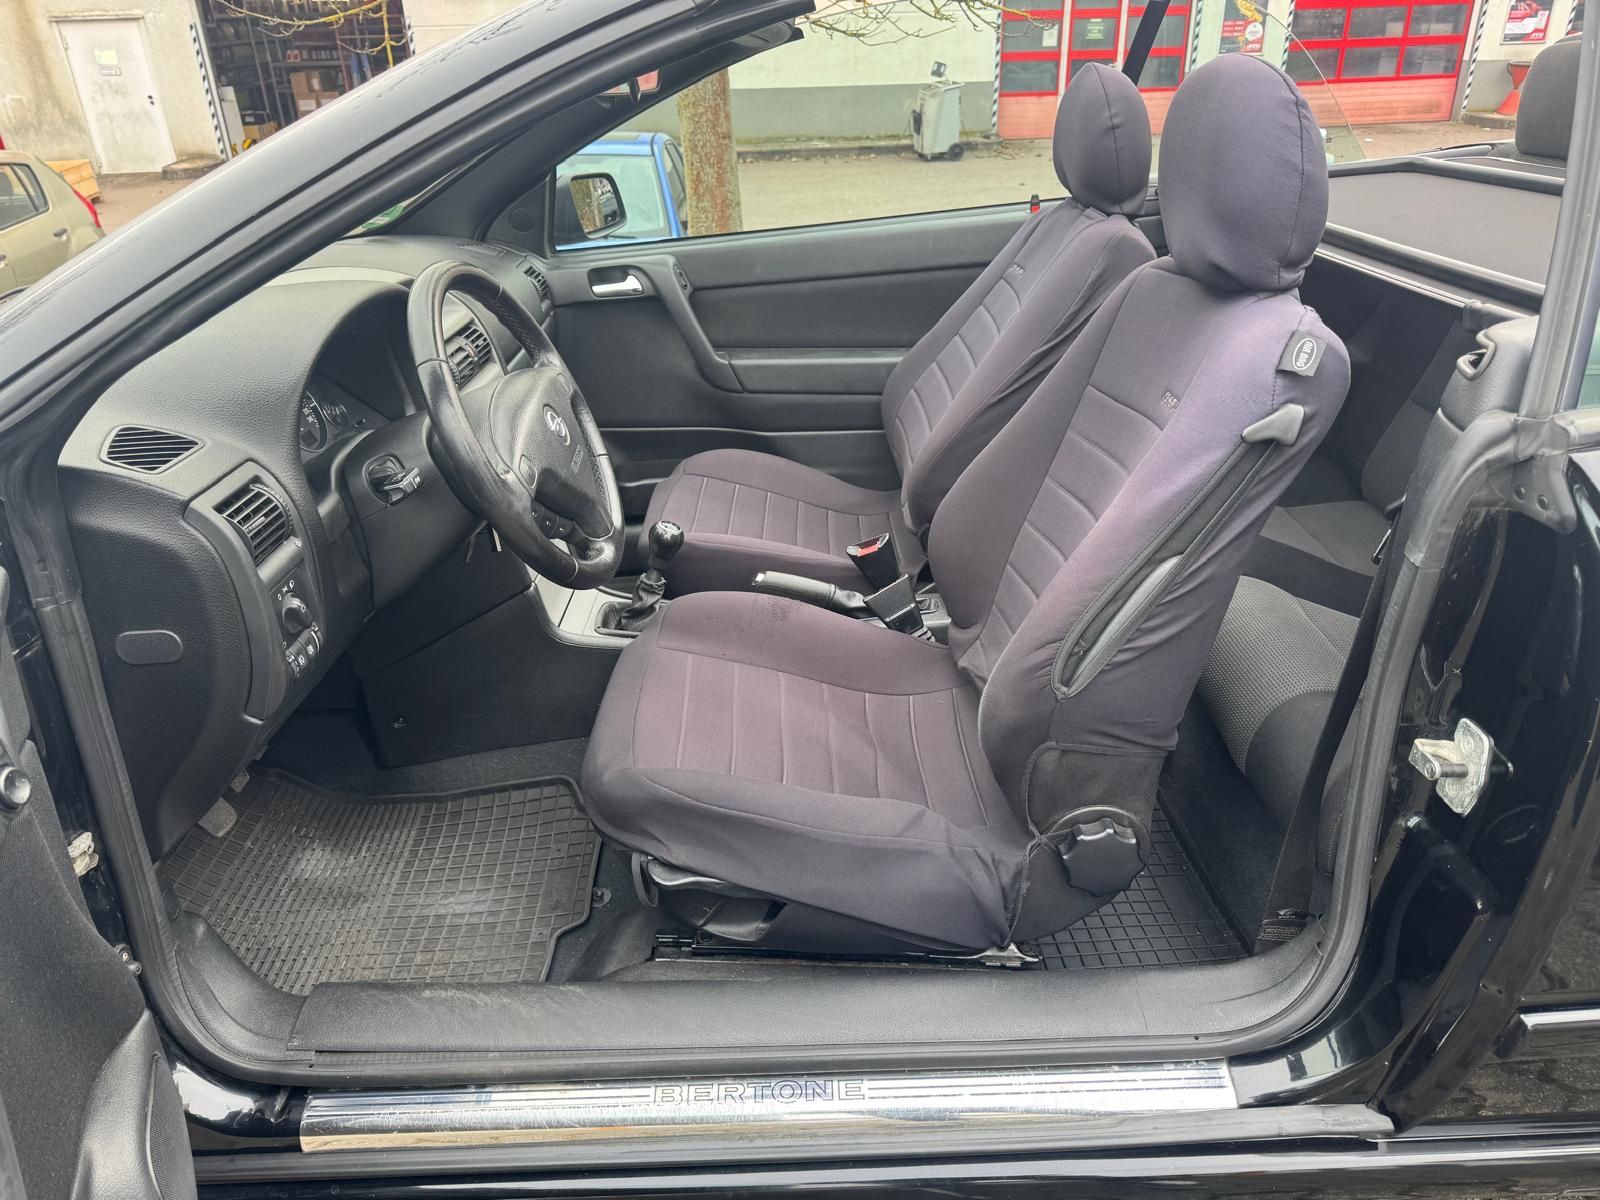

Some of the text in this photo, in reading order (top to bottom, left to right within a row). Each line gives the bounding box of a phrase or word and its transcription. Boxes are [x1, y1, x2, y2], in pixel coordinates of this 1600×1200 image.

[1296, 340, 1313, 366] AIR BAG
[654, 1079, 865, 1104] BERTONE
